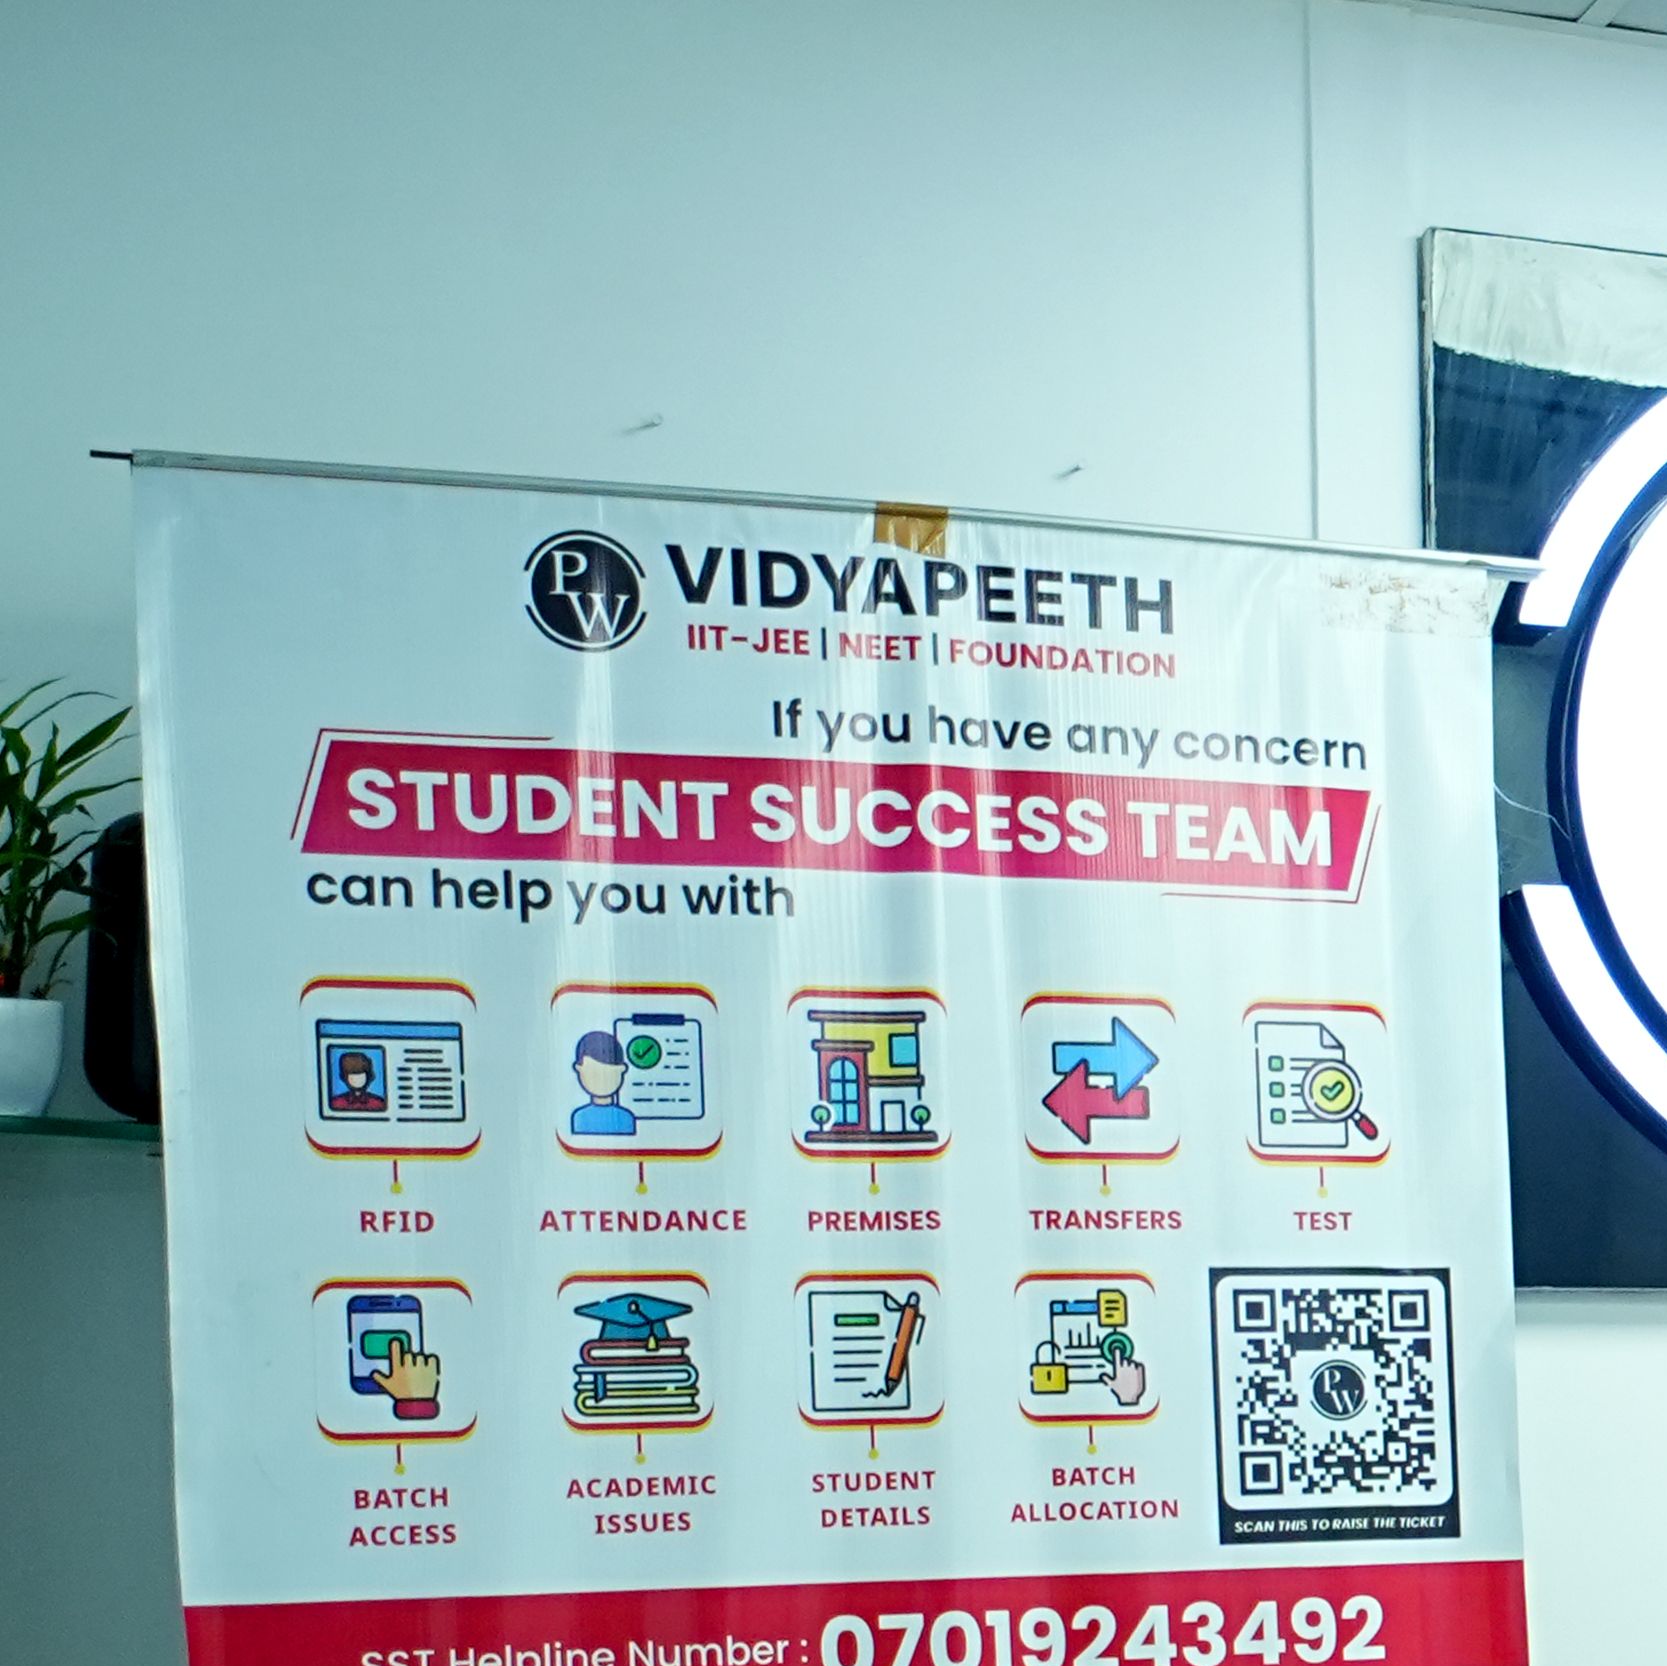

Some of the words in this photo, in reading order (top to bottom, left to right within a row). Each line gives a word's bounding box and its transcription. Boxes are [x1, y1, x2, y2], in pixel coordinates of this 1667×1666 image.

[665, 543, 1174, 635] VIDYAPEETH
[687, 624, 810, 657] IIT-JEE
[839, 633, 921, 664] NEET
[949, 638, 1176, 679] FOUNDATION
[772, 699, 801, 740] If
[816, 708, 912, 752] you
[928, 705, 1052, 751] have
[1066, 724, 1160, 768] any
[1173, 729, 1367, 770] concern
[347, 768, 728, 843] STUDENT
[749, 783, 1110, 856] SUCCESS
[1127, 801, 1332, 867] TEAM
[306, 871, 413, 908] can
[432, 868, 553, 923] help
[568, 880, 667, 924] you
[682, 875, 795, 918] with
[360, 1210, 436, 1233] RFID
[540, 1209, 748, 1232] ATTENDANCE
[807, 1209, 942, 1233] PREMISES
[1029, 1209, 1183, 1231] TRANSFERS
[1294, 1211, 1352, 1231] TEST
[566, 1474, 717, 1499] ACADEMIC
[811, 1469, 937, 1493] STUDENT
[1051, 1465, 1136, 1487] BATCH
[354, 1487, 449, 1510] BATCH
[595, 1511, 692, 1535] ISSUES
[821, 1505, 931, 1528] DETAILS
[1010, 1498, 1180, 1524] ALLOCATION
[349, 1523, 458, 1547] ACCESS
[1234, 1519, 1275, 1534] SCAN
[1278, 1518, 1308, 1533] THIS
[1311, 1518, 1329, 1531] TO
[1332, 1517, 1370, 1530] RAISE
[1373, 1516, 1396, 1529] THE
[1399, 1515, 1446, 1528] TICKET
